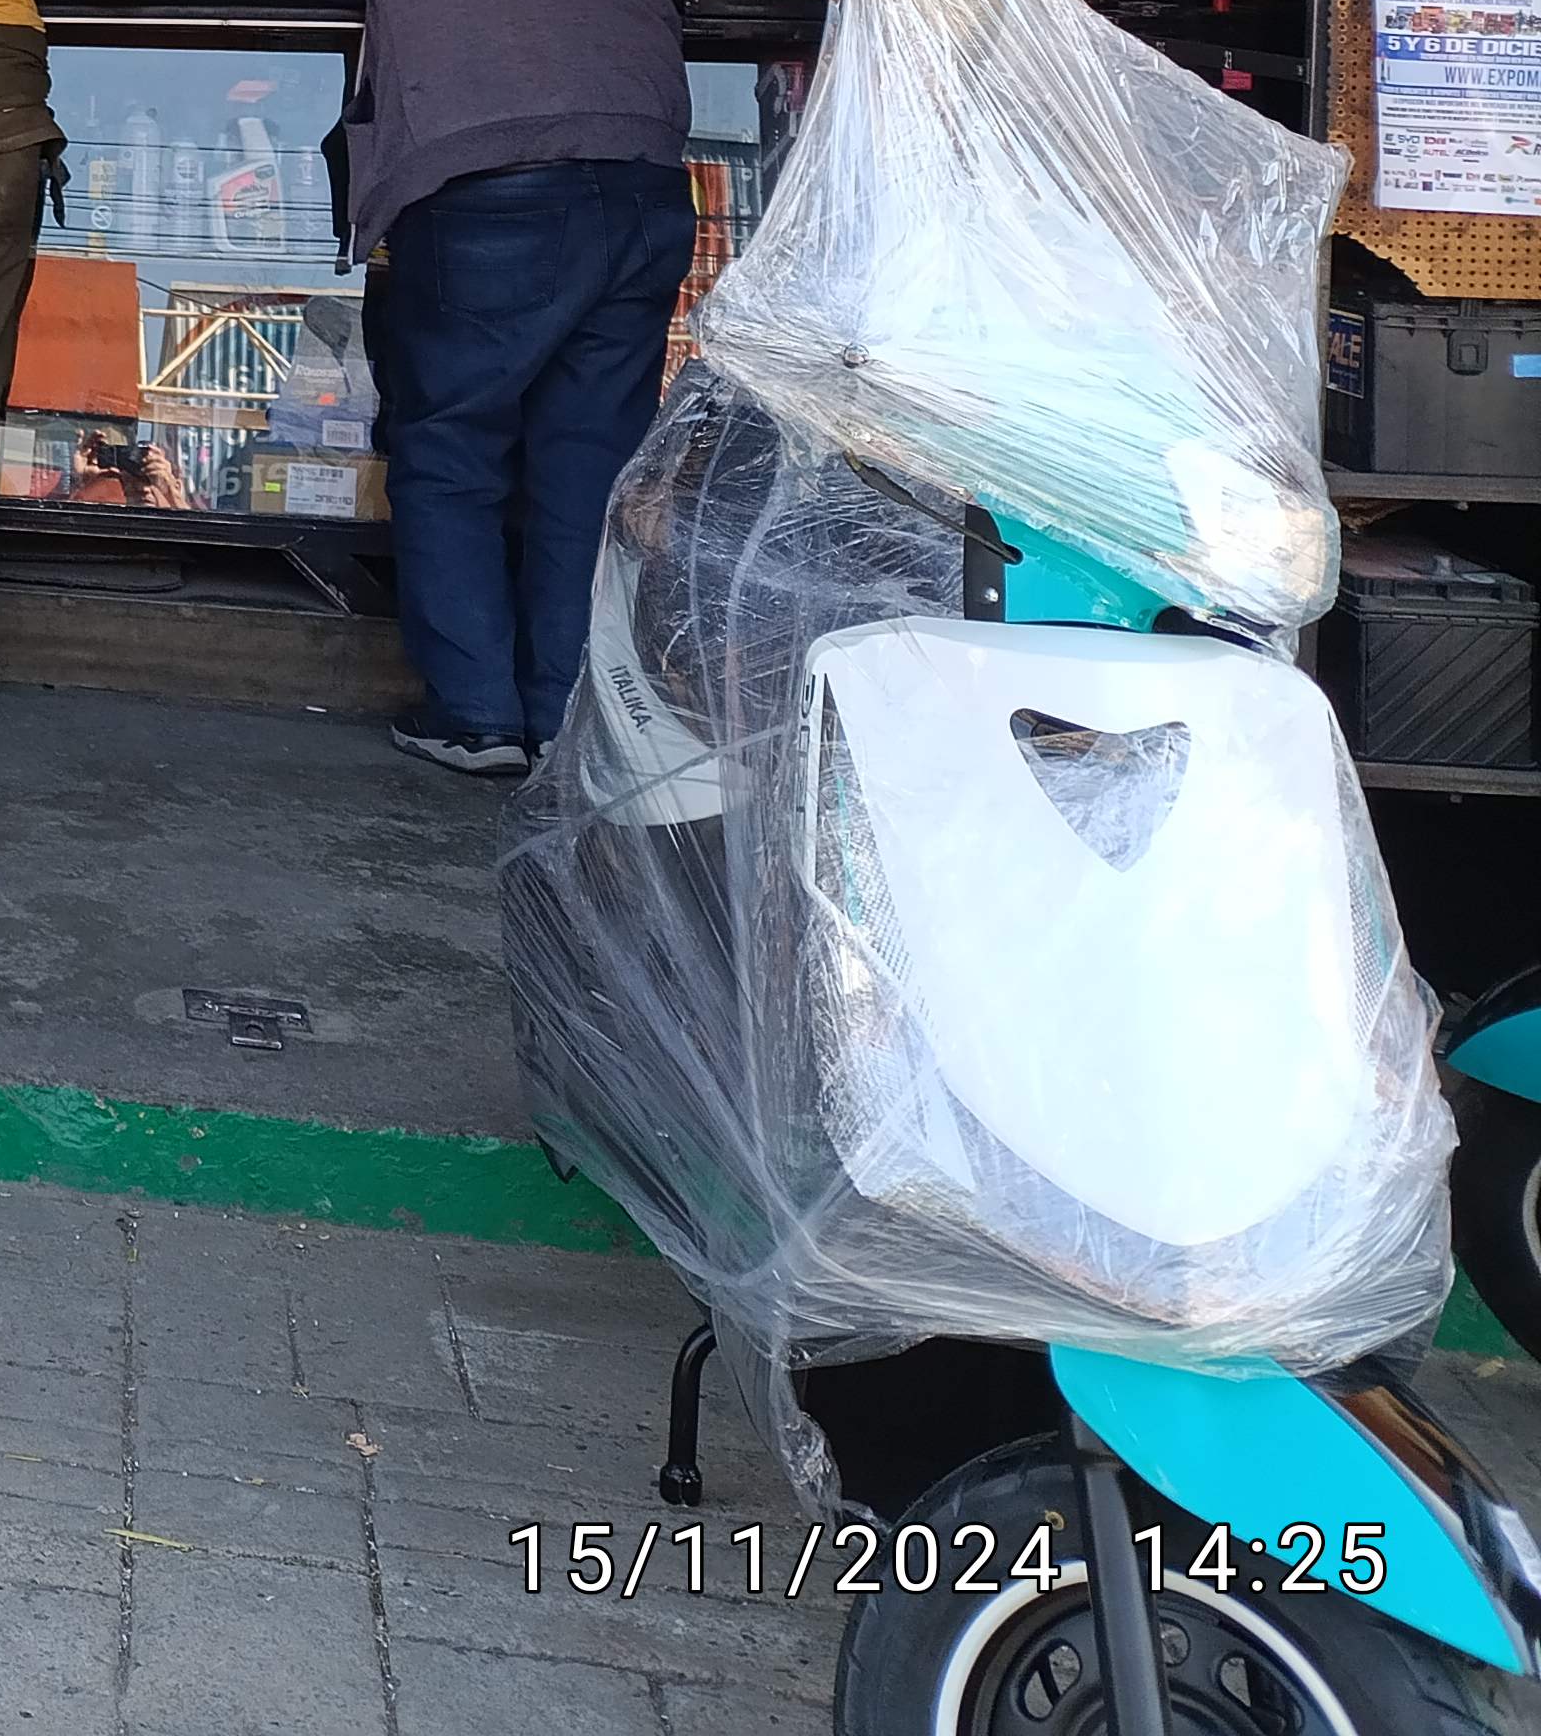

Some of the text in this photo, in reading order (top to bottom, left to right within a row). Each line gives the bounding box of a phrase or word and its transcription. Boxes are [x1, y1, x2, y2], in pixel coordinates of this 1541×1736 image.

[1388, 36, 1541, 56] 5 Y 6 DE DICIE
[1445, 66, 1541, 87] WWW.EXPOM
[608, 665, 653, 732] ITALIKA
